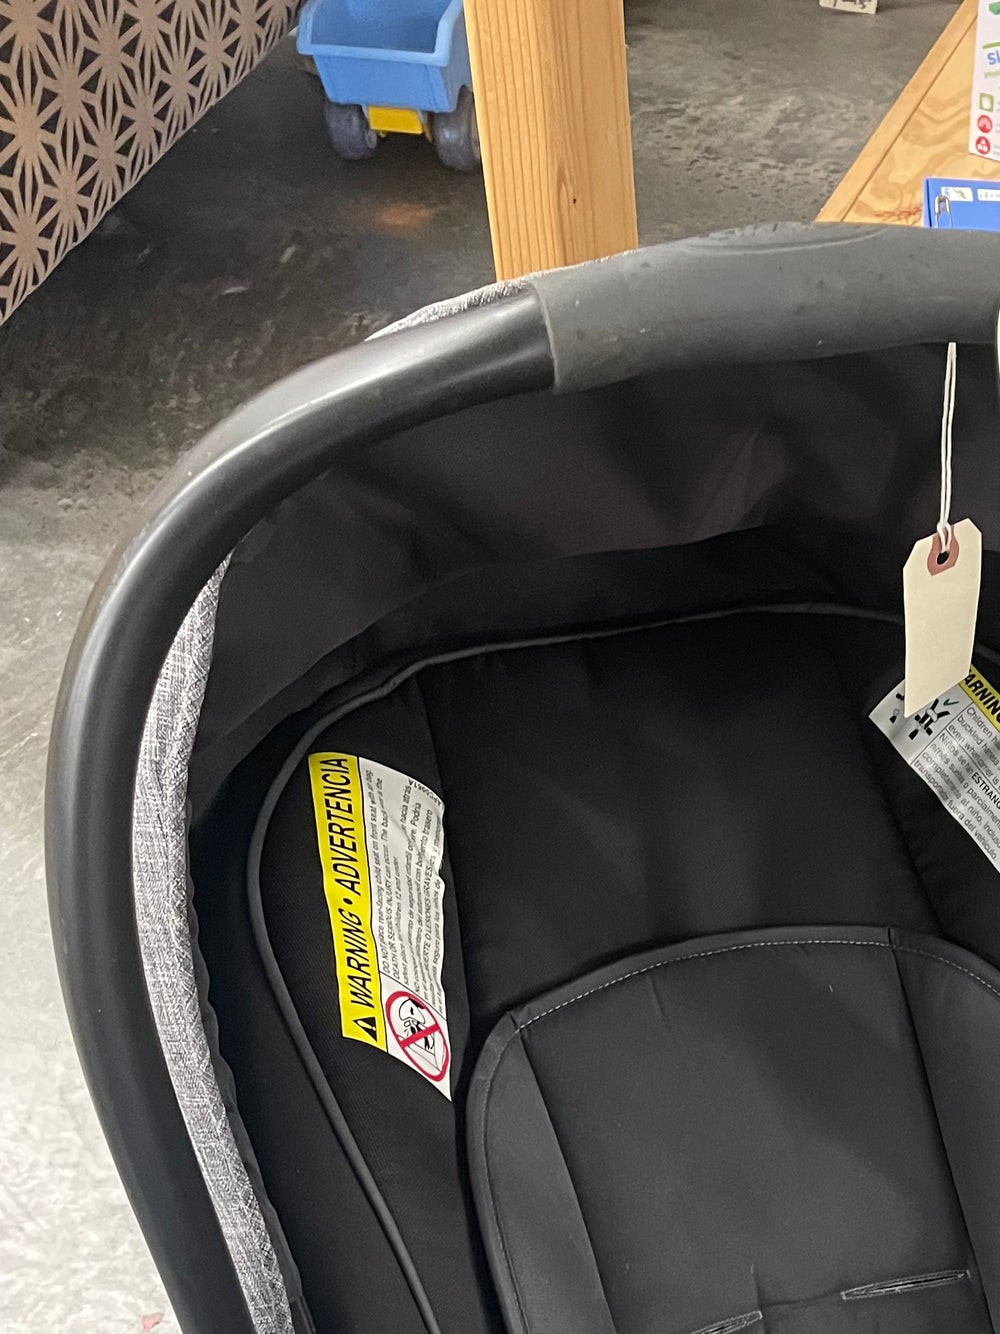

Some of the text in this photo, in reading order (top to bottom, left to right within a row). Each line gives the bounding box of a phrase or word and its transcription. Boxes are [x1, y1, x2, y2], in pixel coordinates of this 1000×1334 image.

[956, 715, 984, 746] buckled
[966, 706, 994, 738] Children
[946, 799, 966, 821] fuera
[963, 818, 977, 832] del
[320, 758, 375, 1008] WARNING ADVERTENCIA
[380, 944, 388, 960] NOT
[383, 961, 390, 974] DO
[391, 955, 400, 979] DEATH
